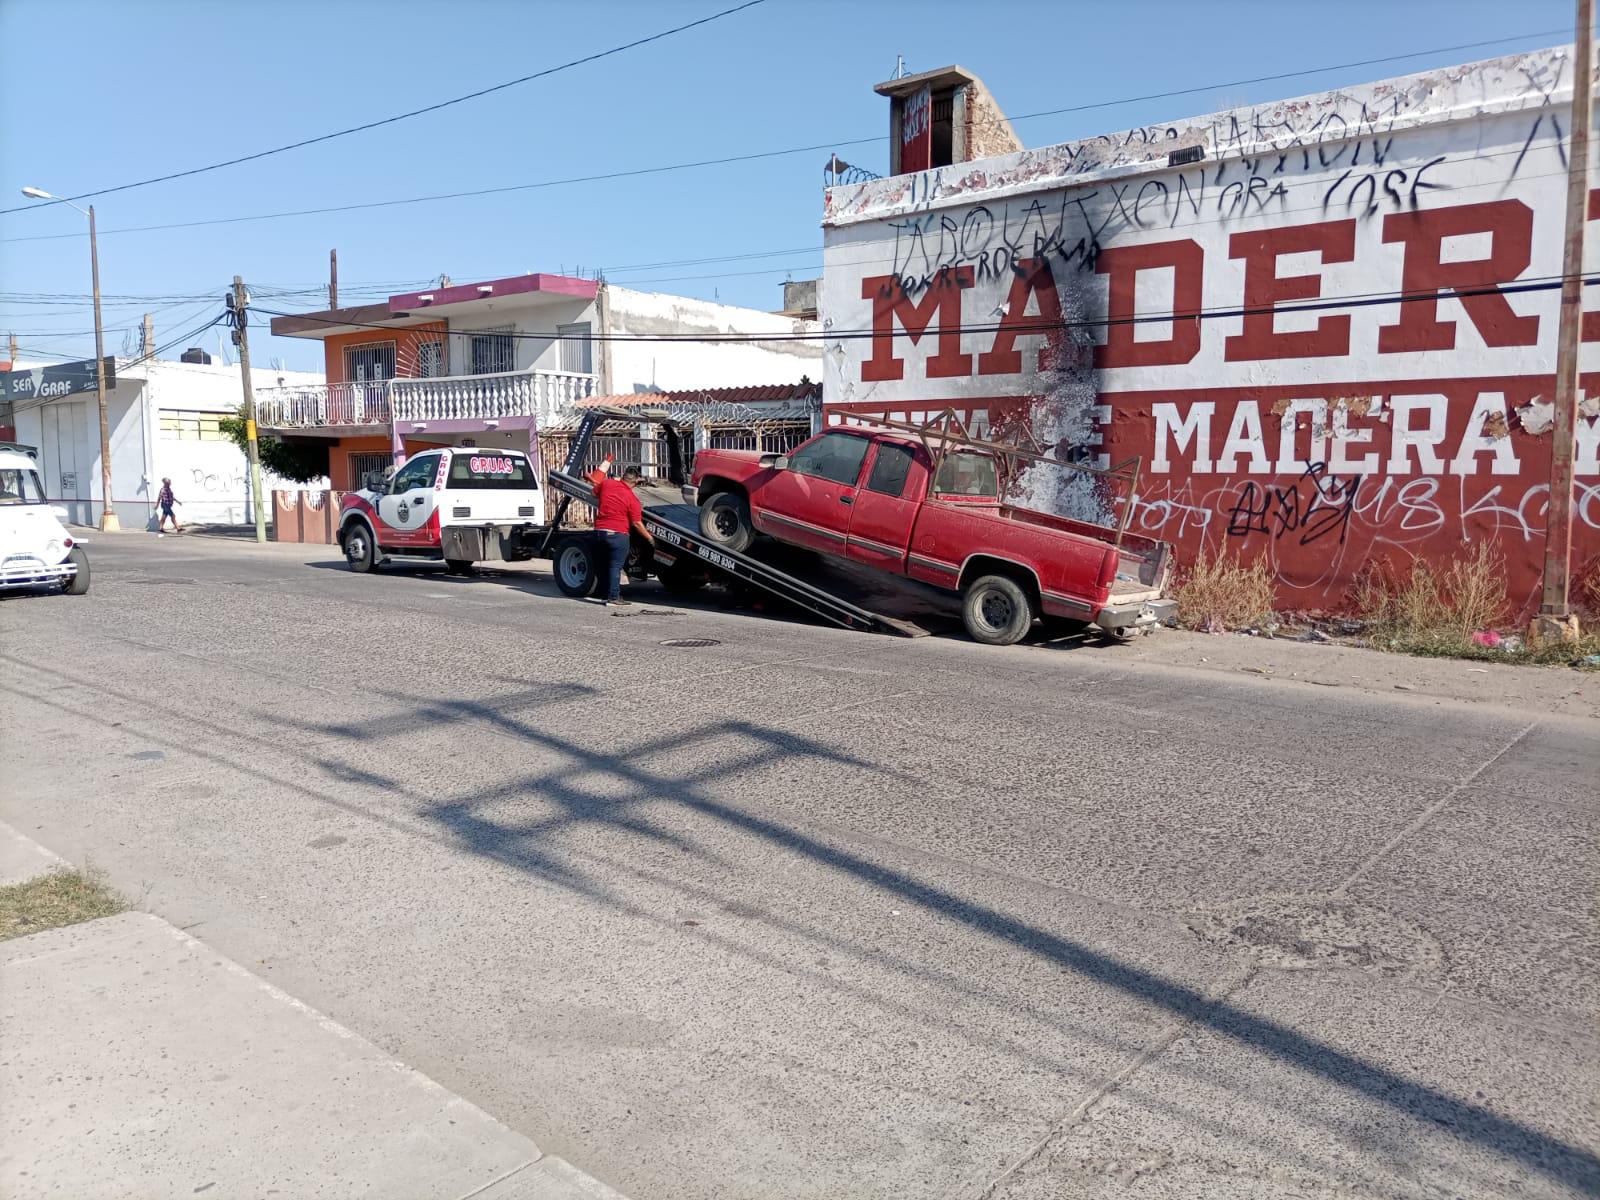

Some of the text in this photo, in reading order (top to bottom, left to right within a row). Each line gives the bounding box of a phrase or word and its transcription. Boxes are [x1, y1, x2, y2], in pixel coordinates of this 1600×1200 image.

[861, 192, 1600, 381] MADER
[1151, 392, 1520, 475] MADERA
[434, 455, 448, 492] GRUAS
[470, 456, 513, 474] GRUAS
